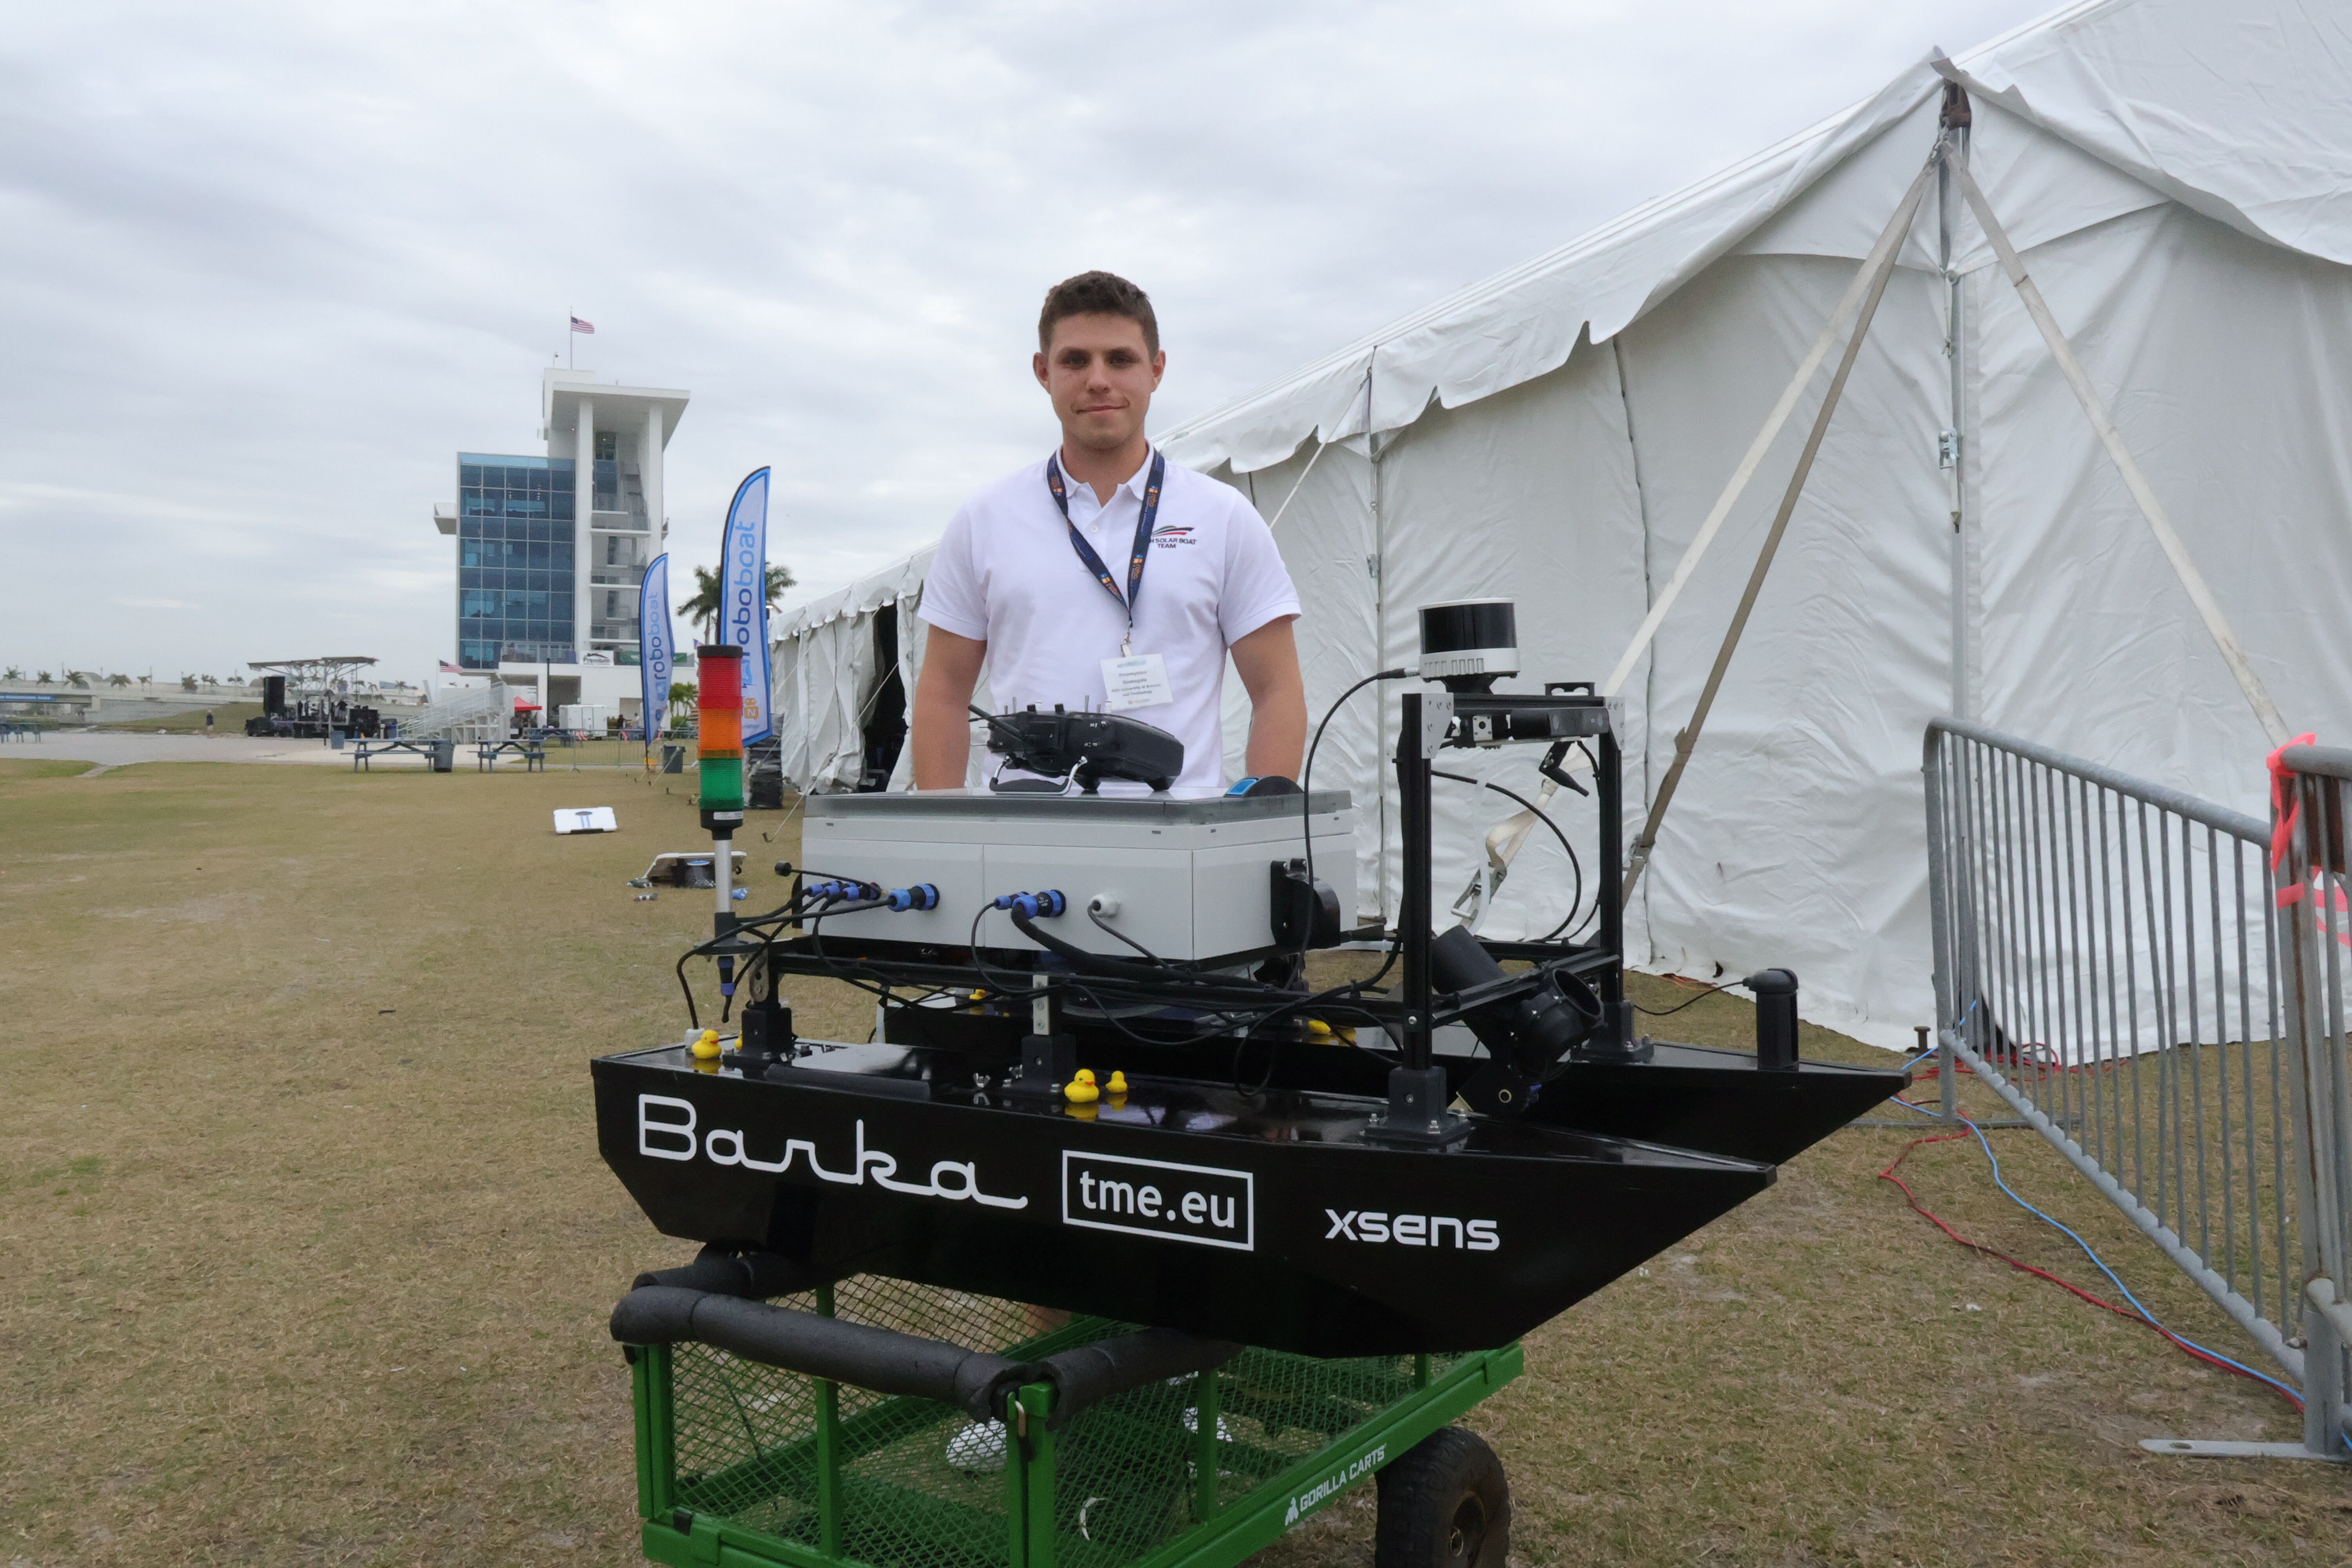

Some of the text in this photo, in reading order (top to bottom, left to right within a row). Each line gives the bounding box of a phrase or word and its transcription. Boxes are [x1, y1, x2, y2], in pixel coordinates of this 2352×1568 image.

[648, 592, 666, 680] roboboat
[639, 1094, 1028, 1209] Barka
[1080, 1171, 1234, 1228] tme.eu
[1300, 1445, 1385, 1512] GORILLA CARTS
